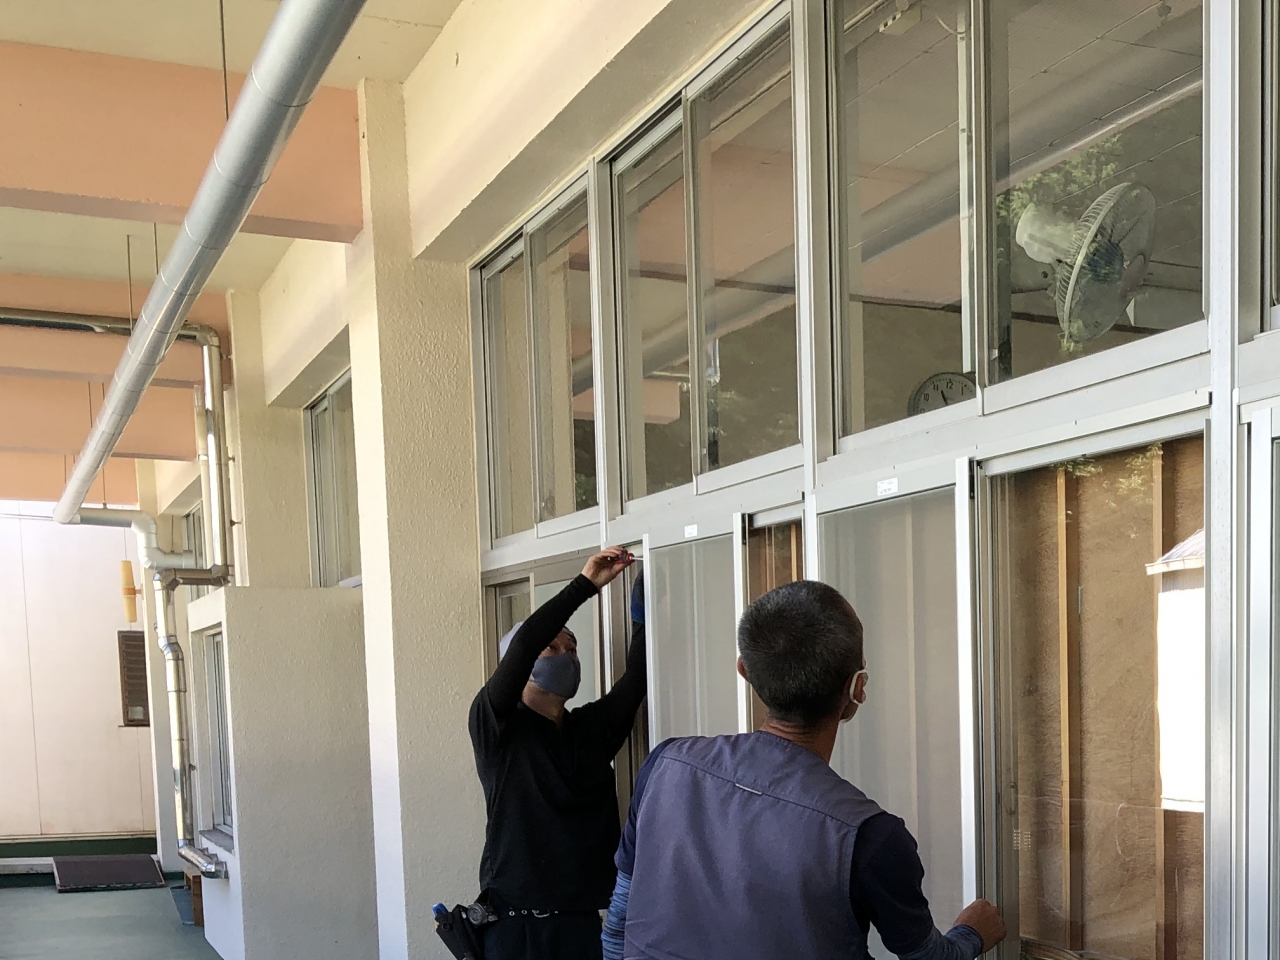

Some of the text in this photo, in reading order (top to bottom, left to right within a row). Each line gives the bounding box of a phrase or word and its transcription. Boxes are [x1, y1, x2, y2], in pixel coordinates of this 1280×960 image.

[933, 383, 939, 391] 11
[946, 381, 953, 390] 12
[923, 392, 930, 402] 10
